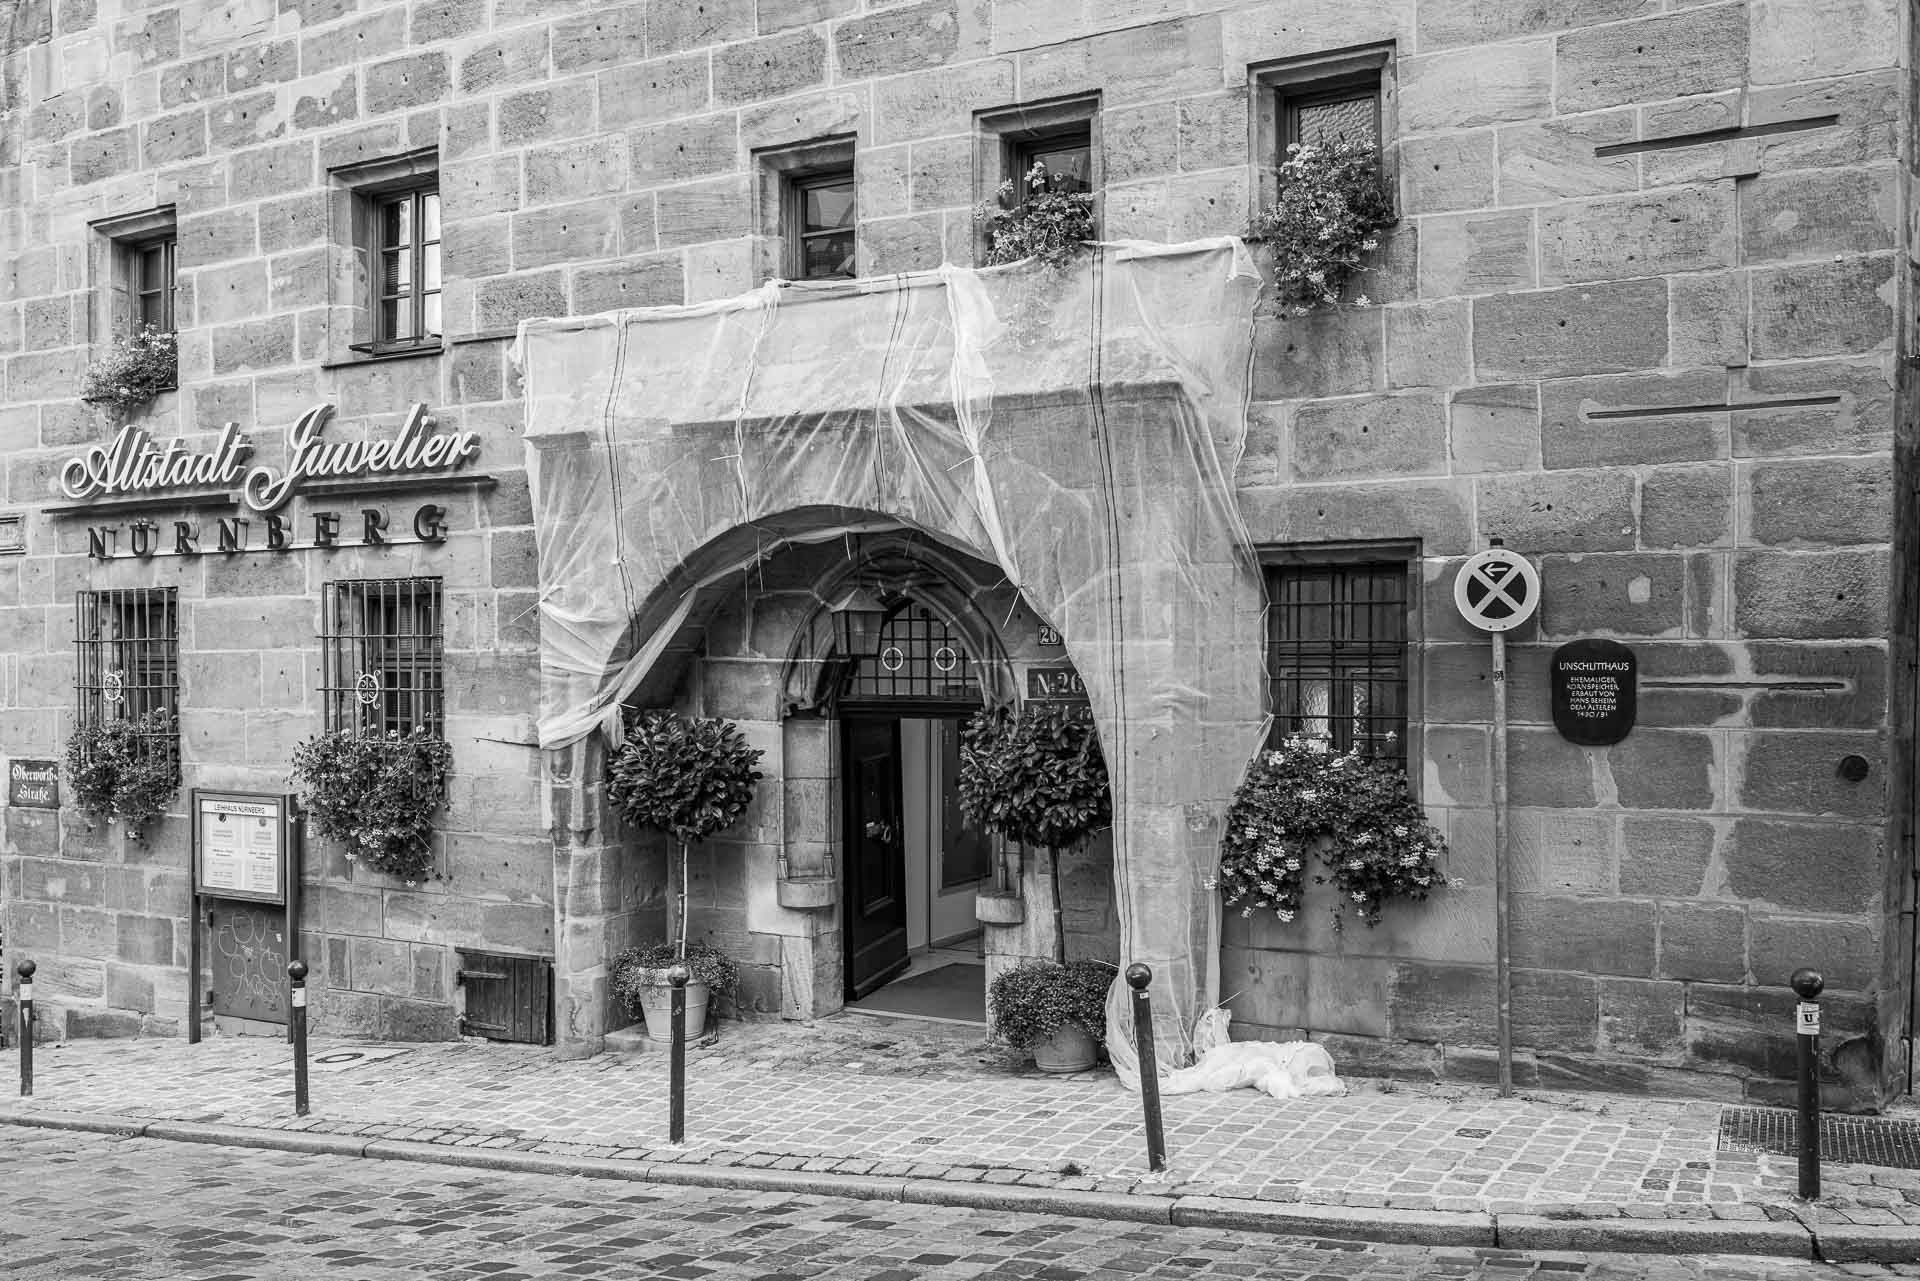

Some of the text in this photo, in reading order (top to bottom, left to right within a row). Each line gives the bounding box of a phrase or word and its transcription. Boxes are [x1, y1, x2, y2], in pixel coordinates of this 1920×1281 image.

[61, 403, 480, 511] Altstadt Juwelier
[88, 504, 448, 558] NÜRNBERG
[1041, 627, 1057, 642] 26
[1559, 662, 1630, 671] UNSCHLITTHAUS
[1570, 676, 1617, 684] EHEMALIGER
[1566, 683, 1620, 691] KORNSPEICHER
